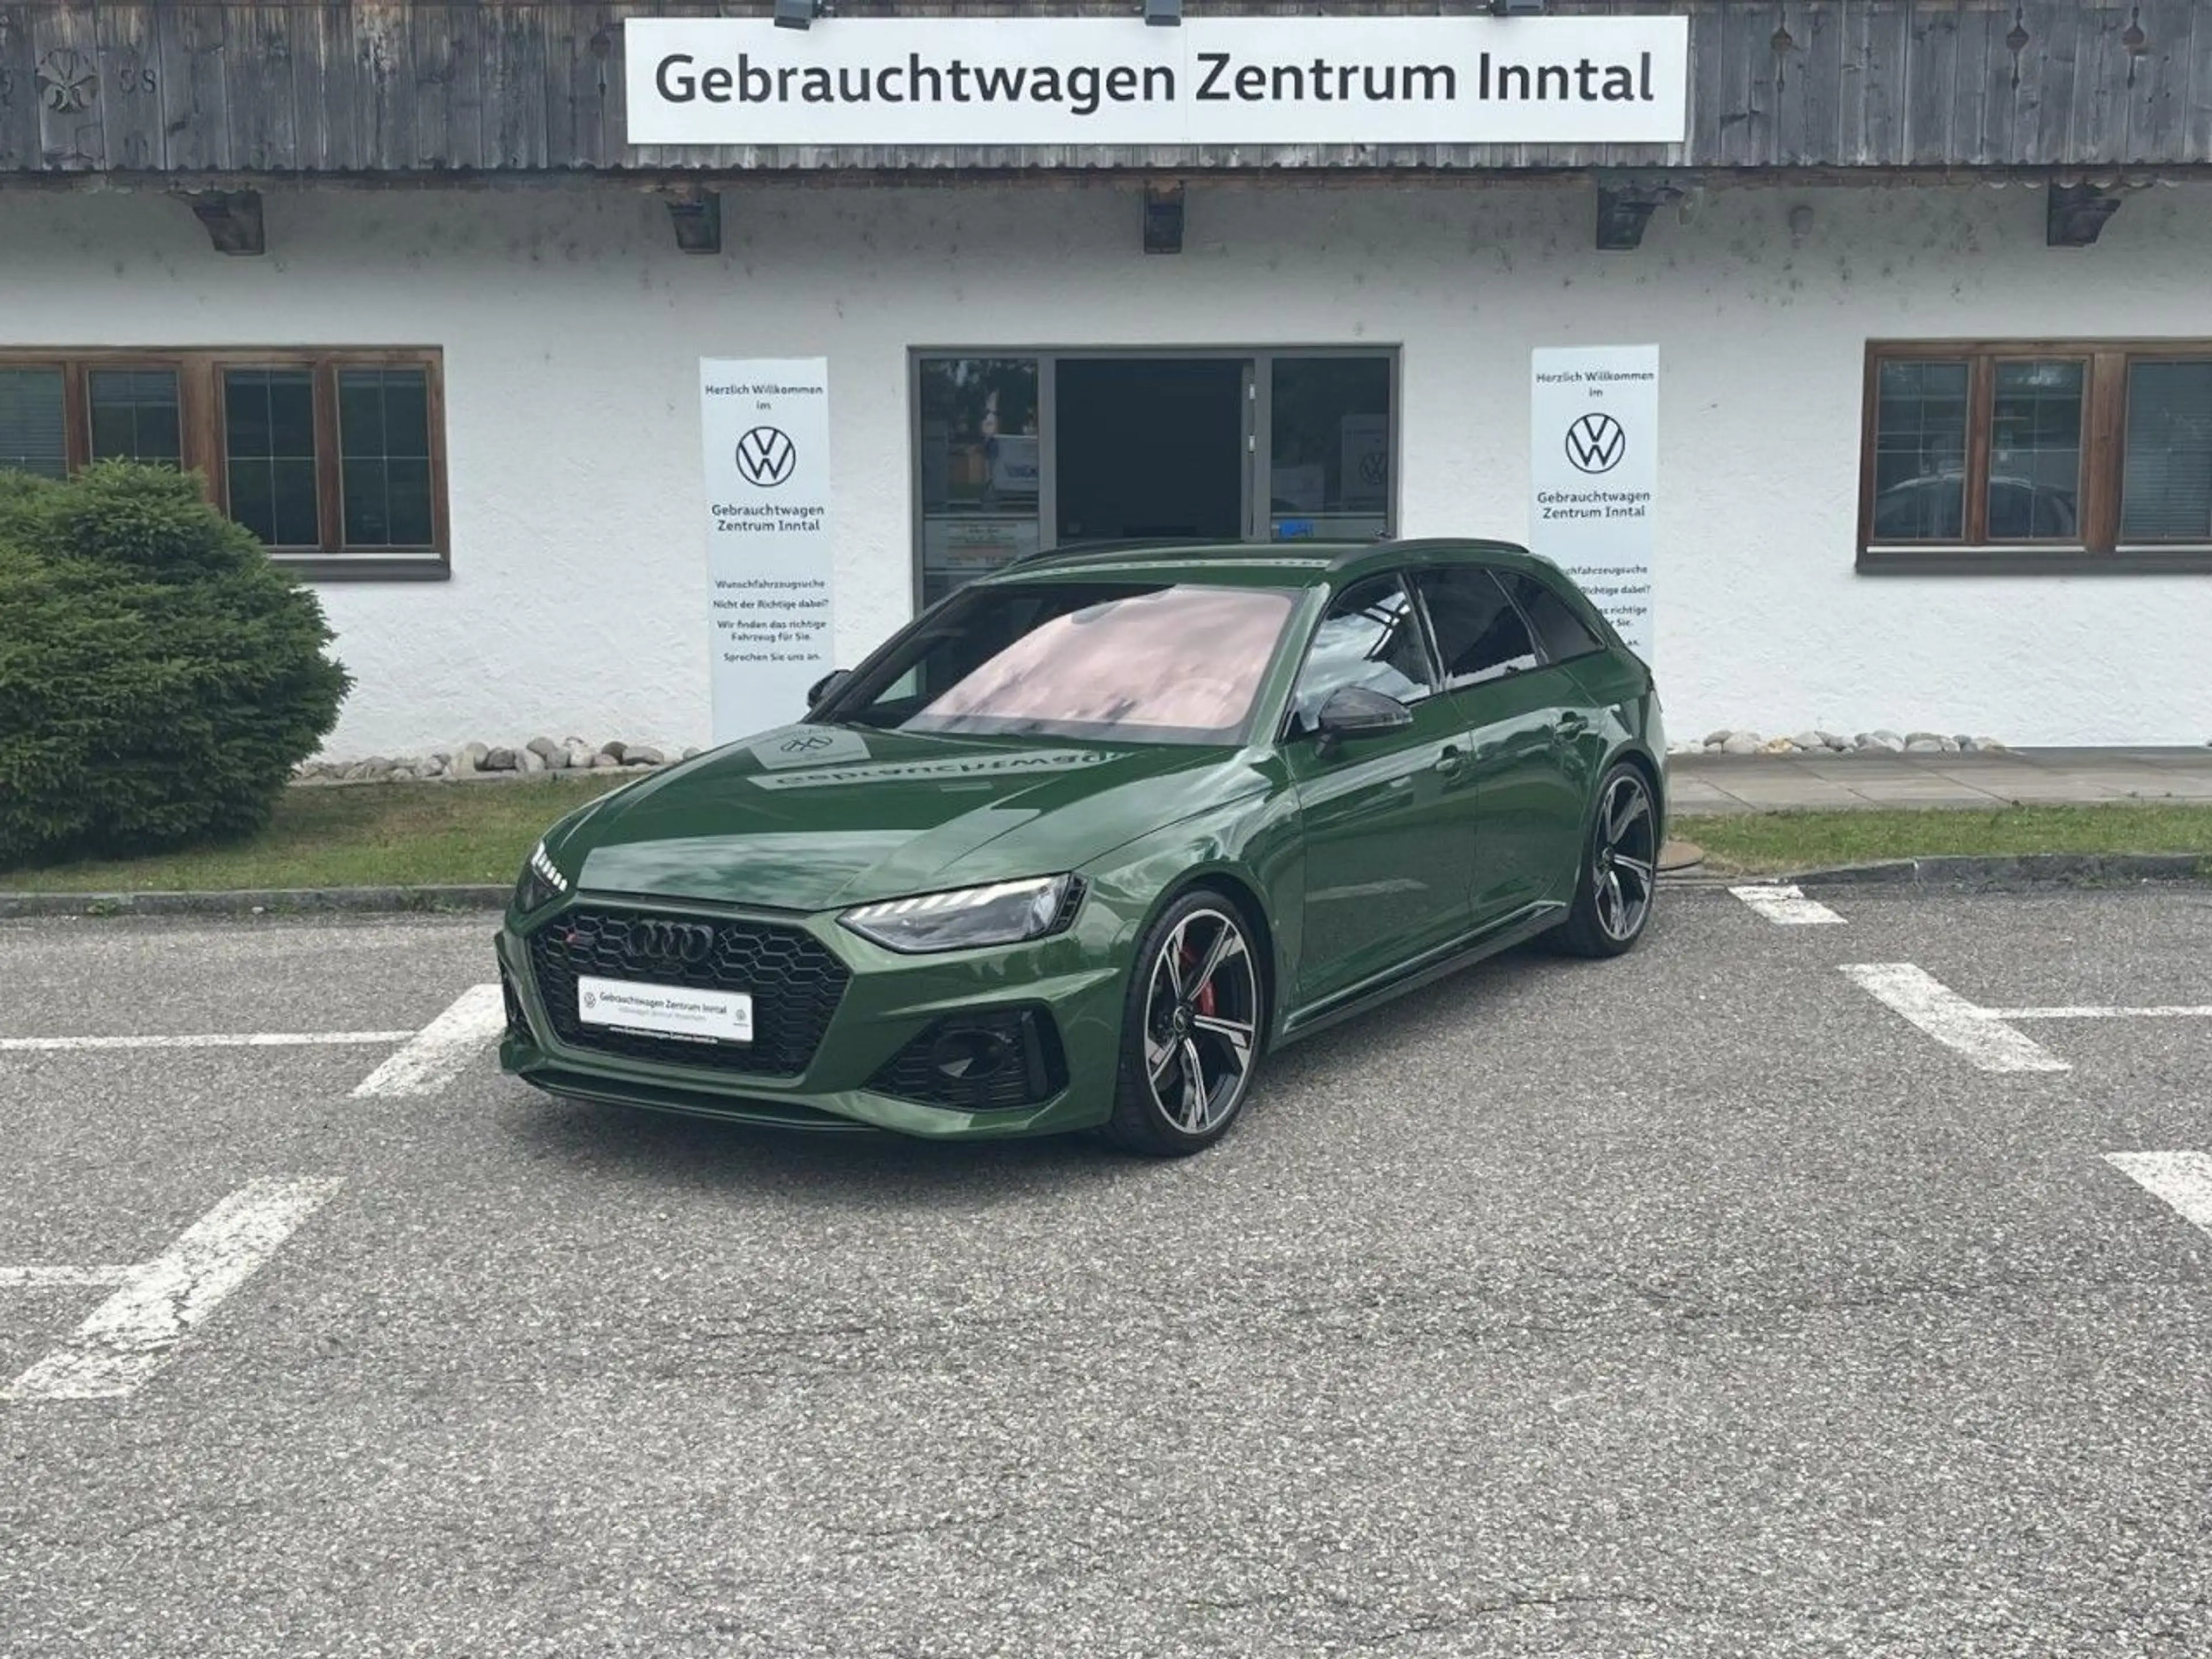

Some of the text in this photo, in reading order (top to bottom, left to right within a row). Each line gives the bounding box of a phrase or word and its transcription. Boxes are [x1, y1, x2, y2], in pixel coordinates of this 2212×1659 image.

[657, 52, 1653, 115] Gebrauchtwagen Zentrum Inntal
[1536, 372, 1654, 382] Herzlich Willkommen
[705, 384, 823, 395] Herzlich Willkommen
[1589, 387, 1603, 397] im
[756, 400, 771, 410] im
[1537, 491, 1650, 505] Gebrauchtwagen
[711, 503, 824, 517] Gebrauchtwagen
[1543, 505, 1645, 518] Zentrum Inntal
[718, 520, 820, 532] Zentrum Inntal
[713, 600, 738, 609] Nicht
[739, 600, 755, 609] der
[798, 599, 830, 609] dabei?
[1610, 604, 1647, 616] richtige
[717, 619, 827, 630] Wir finden das richtige
[731, 632, 776, 643] Fahrzeug
[777, 632, 793, 642] für
[724, 652, 768, 662] Sprechen
[770, 653, 785, 662] Sie
[599, 991, 664, 1008] Gebrauchtwagen
[665, 999, 700, 1012] Zentrum
